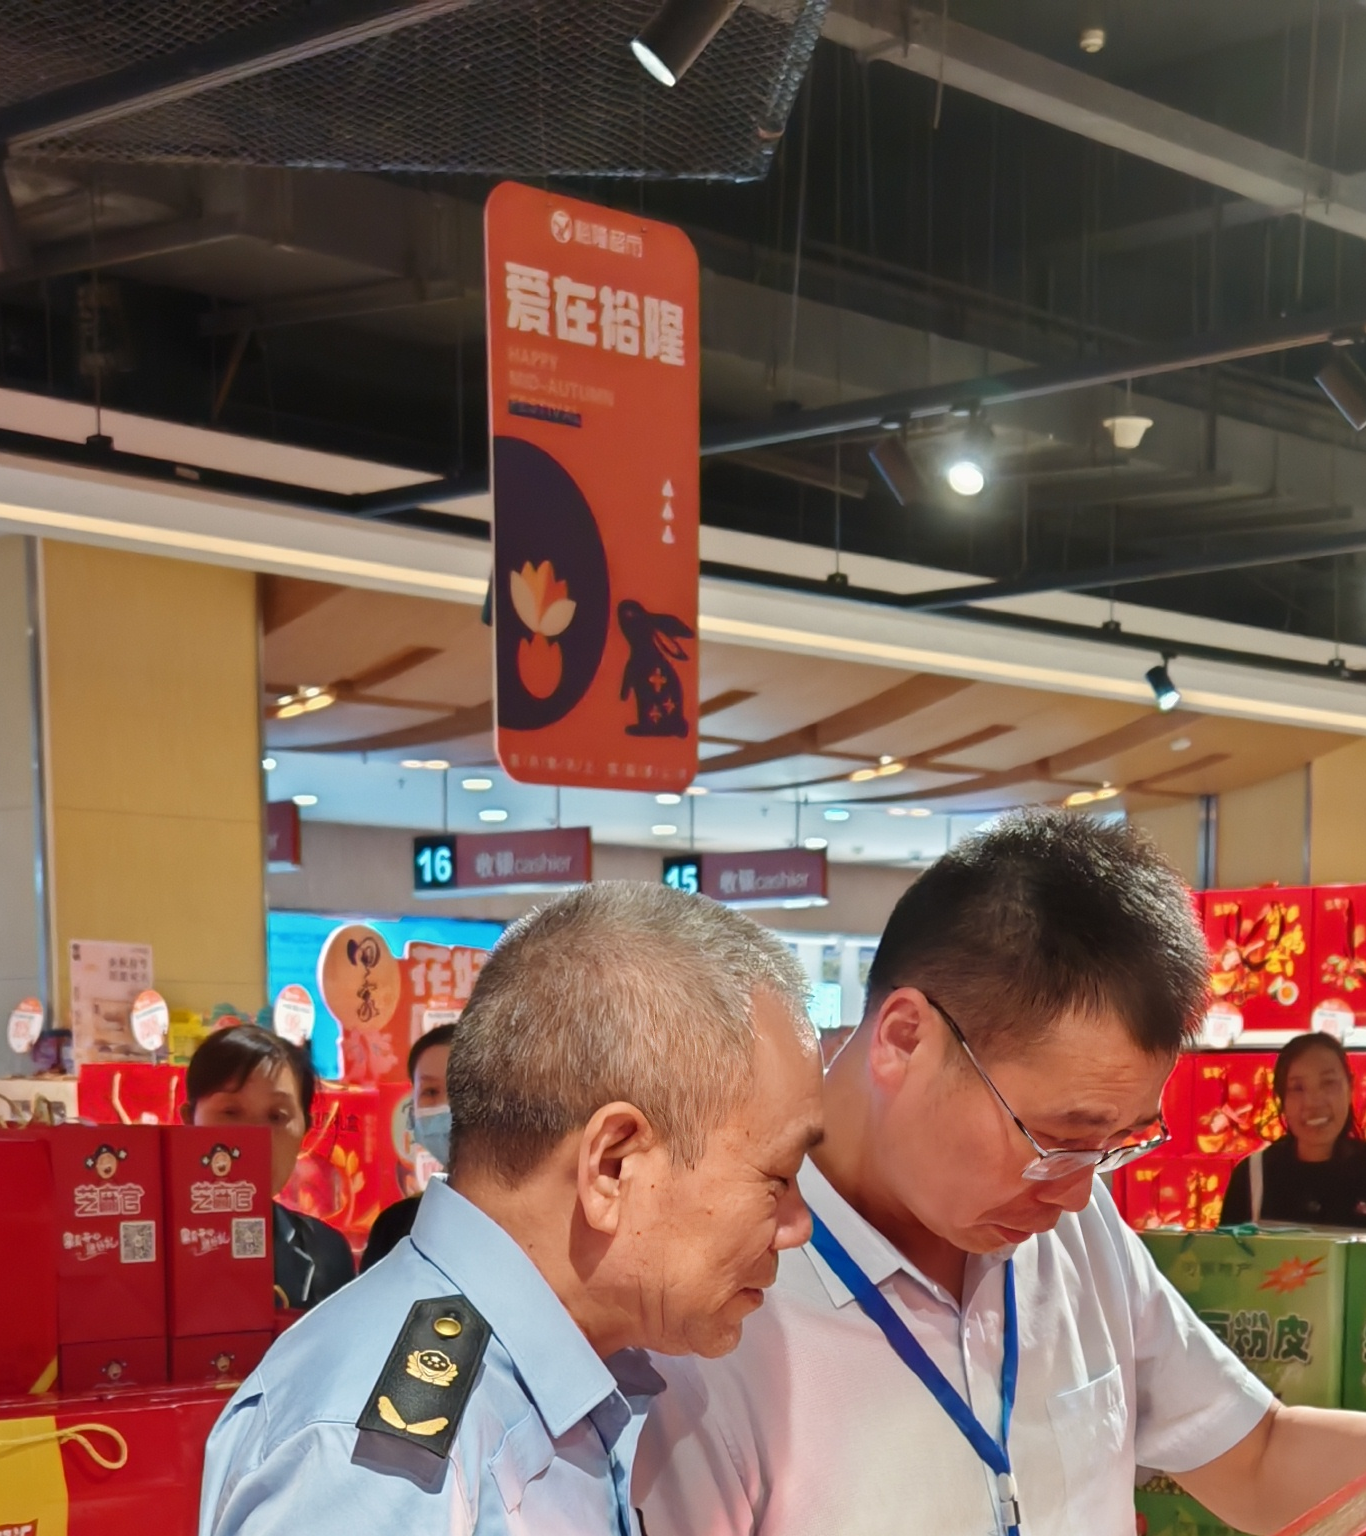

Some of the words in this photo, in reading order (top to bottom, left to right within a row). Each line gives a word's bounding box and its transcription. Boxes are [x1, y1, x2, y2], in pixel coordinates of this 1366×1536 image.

[504, 260, 685, 367] 爱在裕隆
[417, 847, 452, 883] 16
[666, 866, 698, 895] 15
